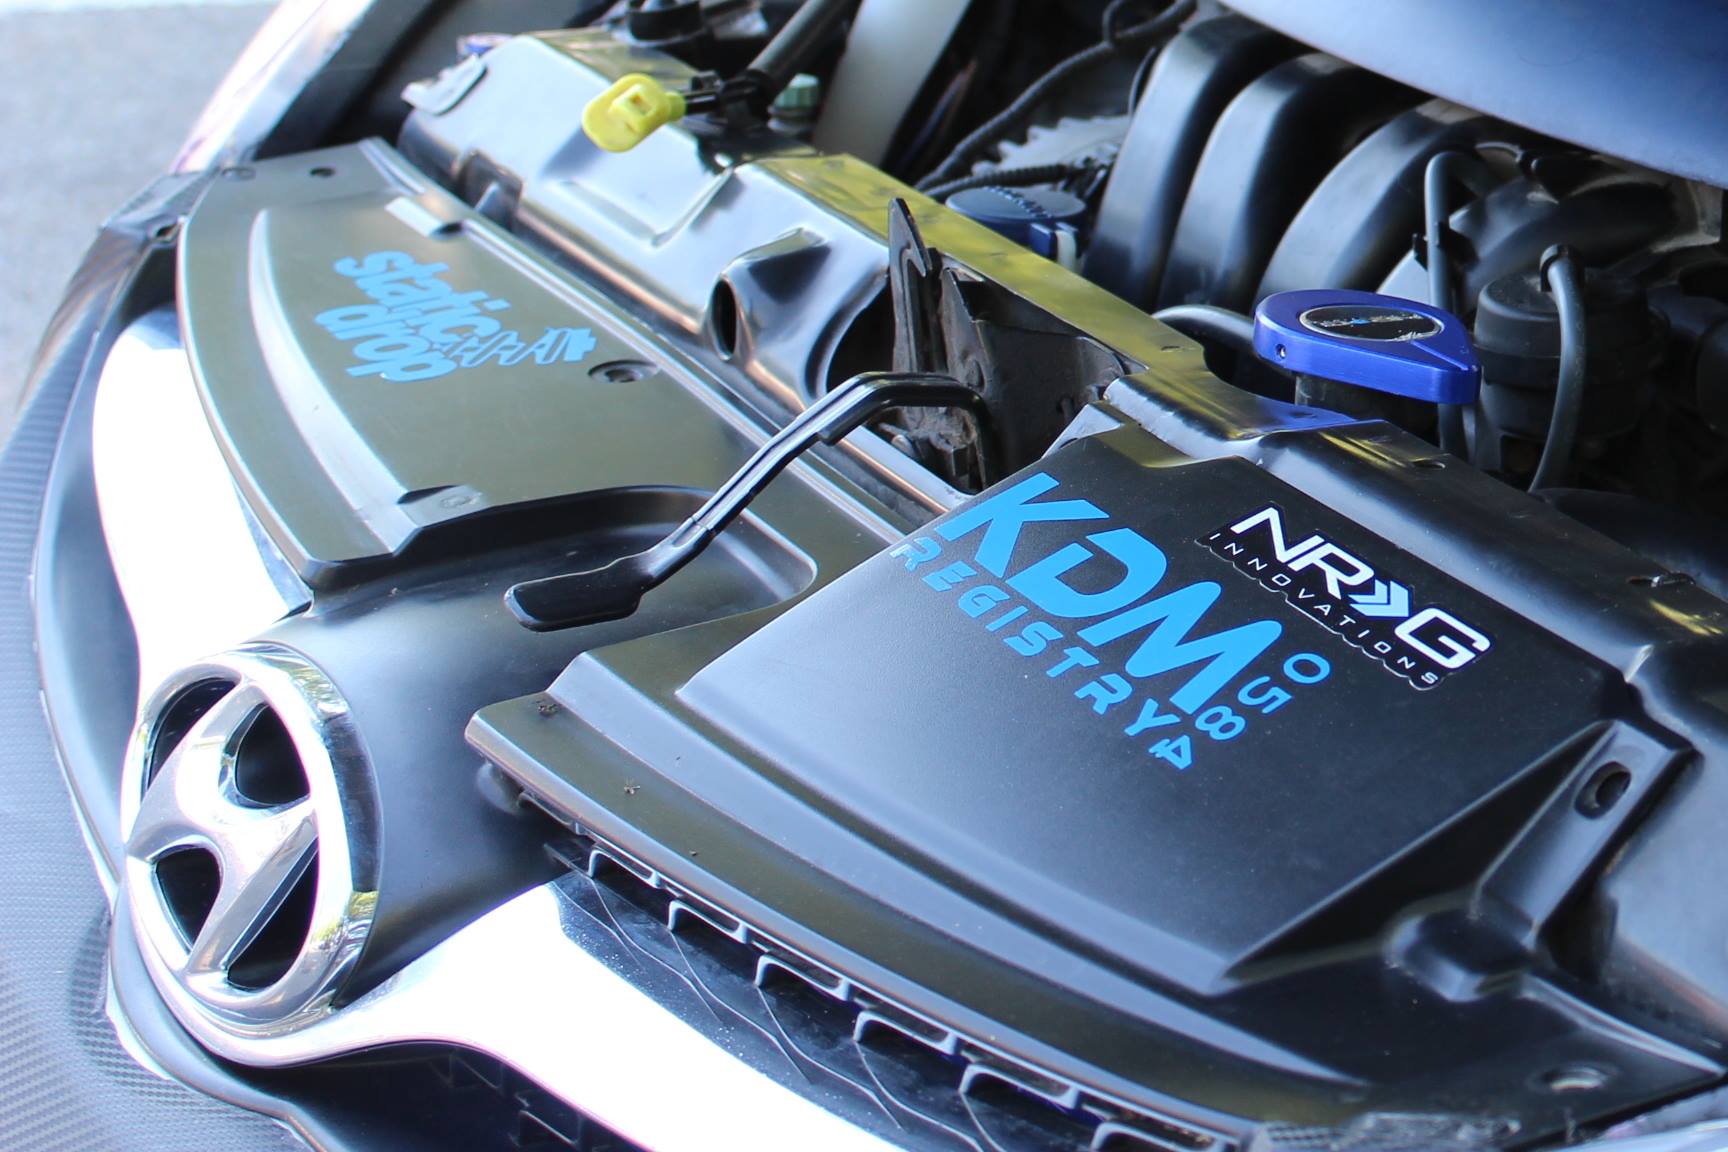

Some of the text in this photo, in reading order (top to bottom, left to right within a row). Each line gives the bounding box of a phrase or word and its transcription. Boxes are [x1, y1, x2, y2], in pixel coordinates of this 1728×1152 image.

[888, 536, 1181, 737] REGISTRY
[933, 471, 1283, 715] KDM
[1209, 532, 1439, 685] INNOVATIONS
